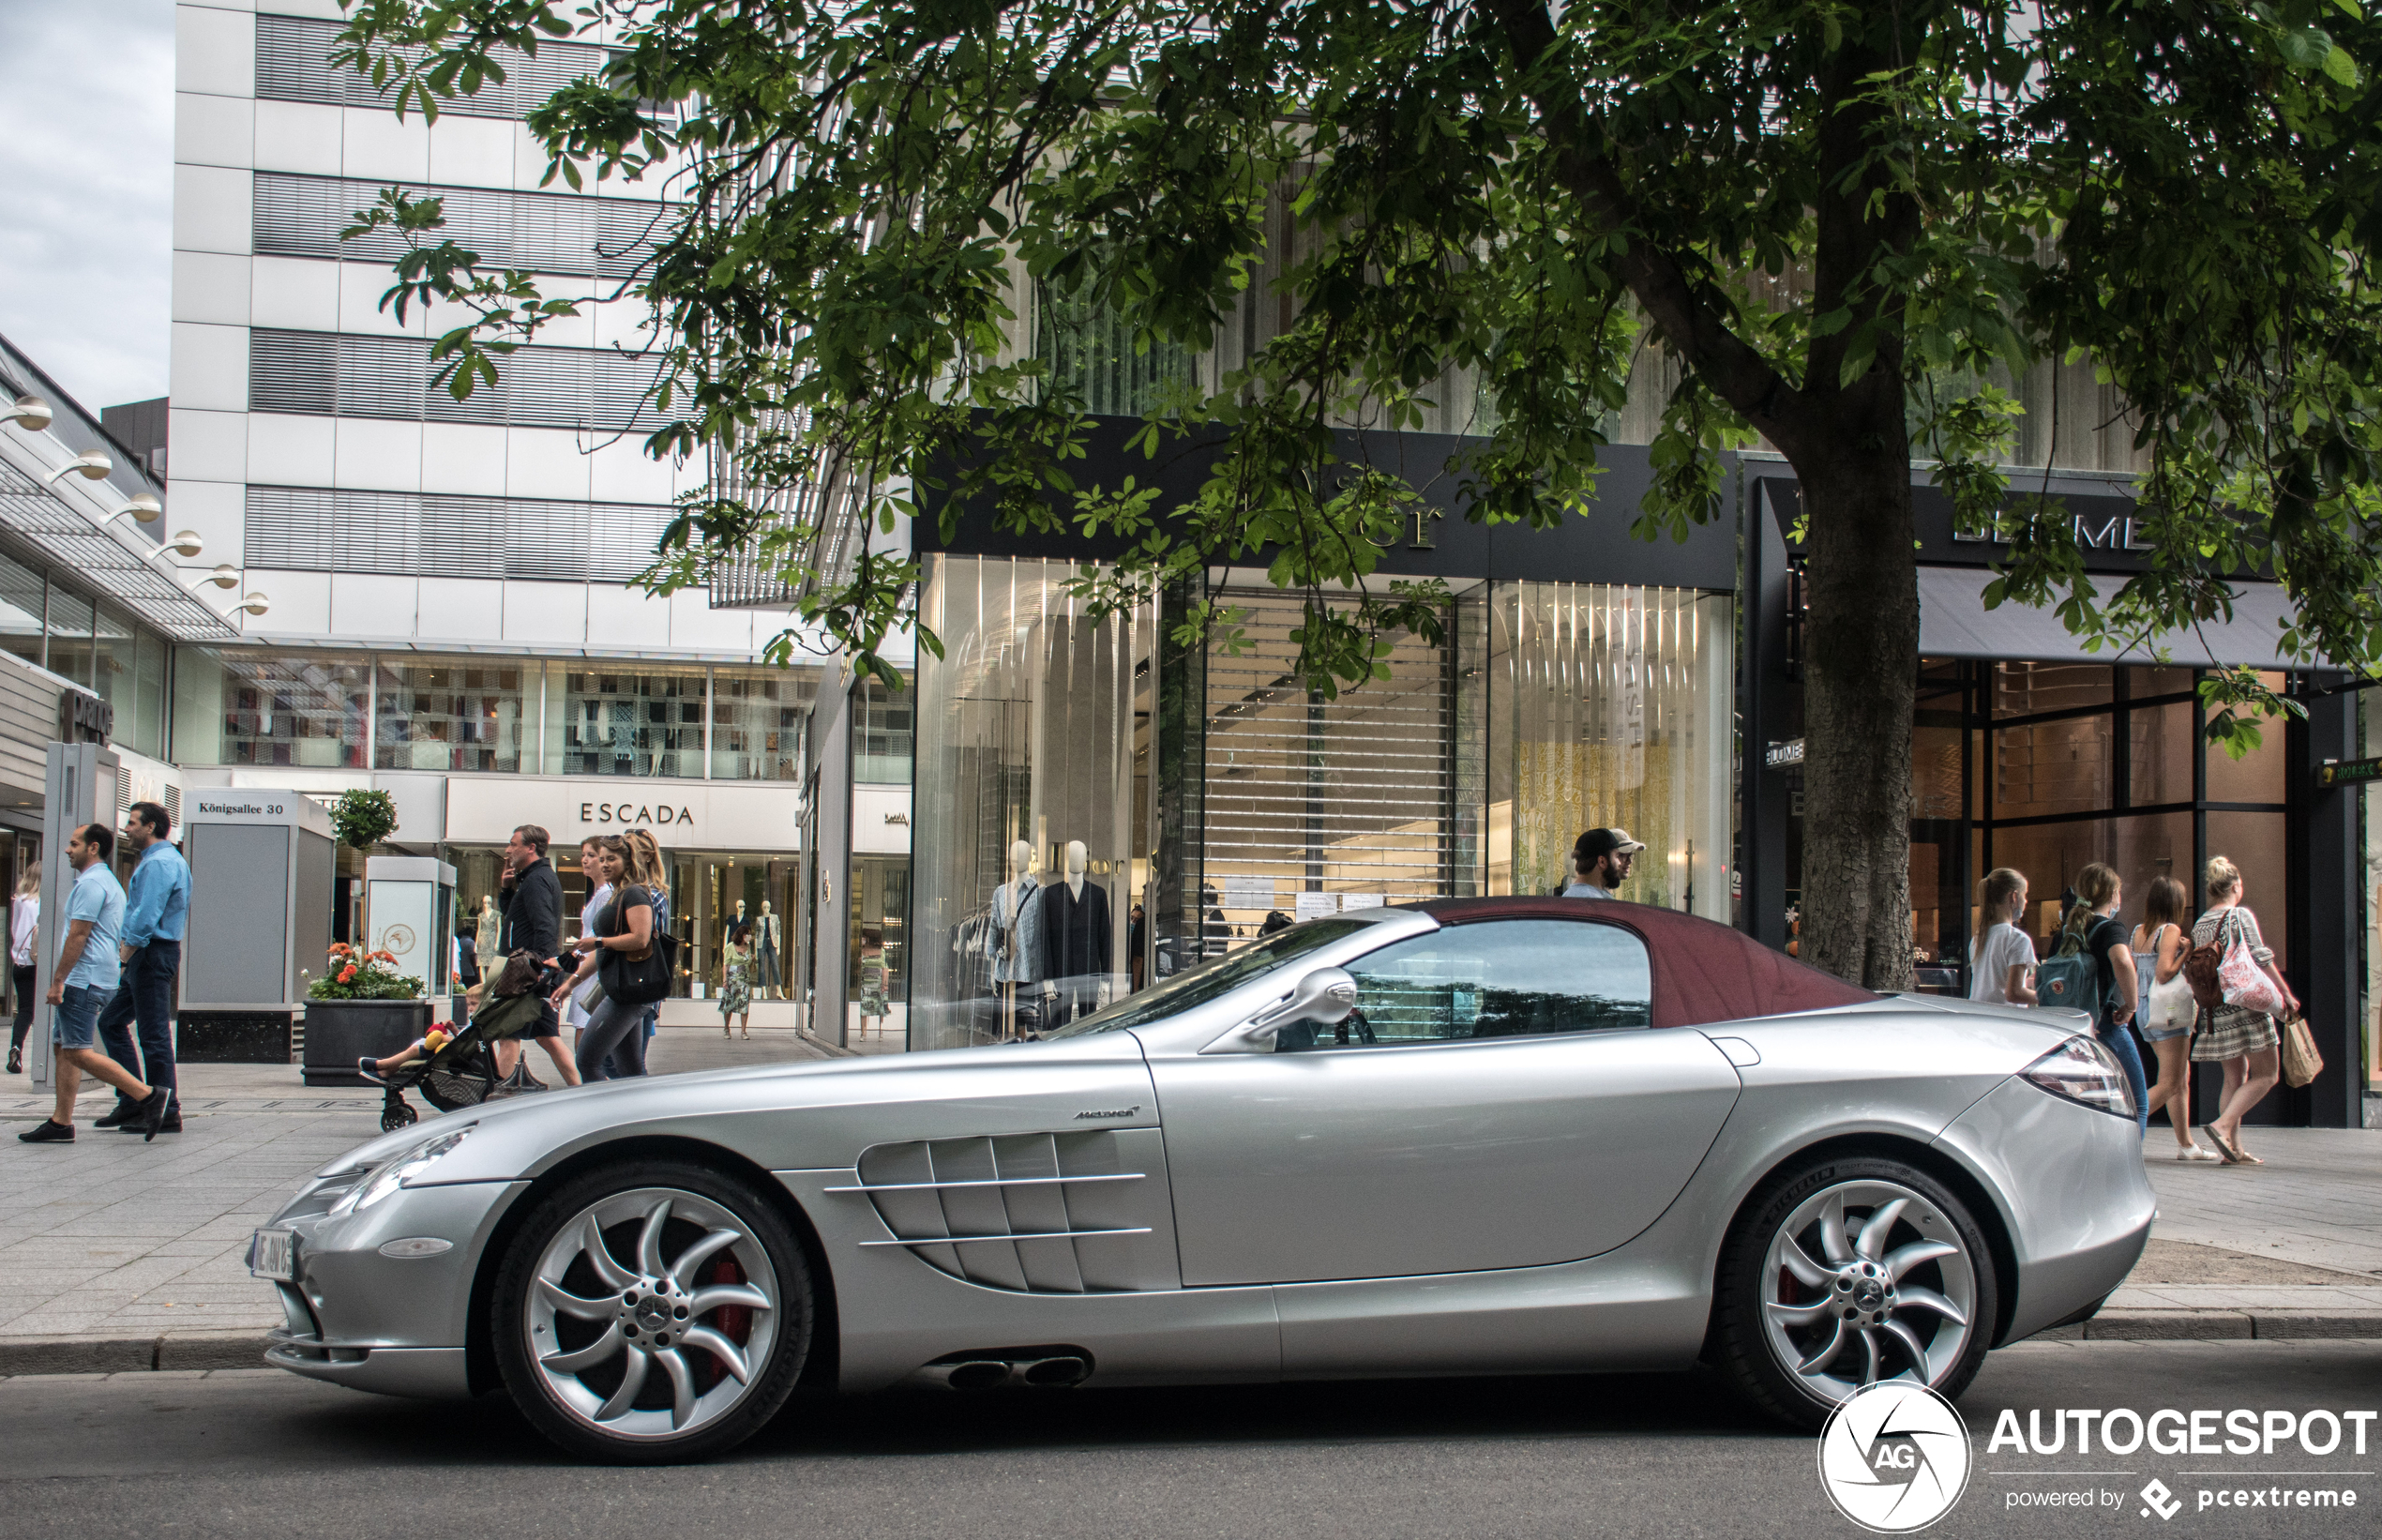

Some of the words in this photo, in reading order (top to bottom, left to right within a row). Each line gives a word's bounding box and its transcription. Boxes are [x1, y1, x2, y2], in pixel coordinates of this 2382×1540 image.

[199, 802, 263, 815] Königsallee
[266, 804, 284, 815] 30
[580, 802, 695, 825] ESCADA
[1766, 1168, 1832, 1221] MICHELIN
